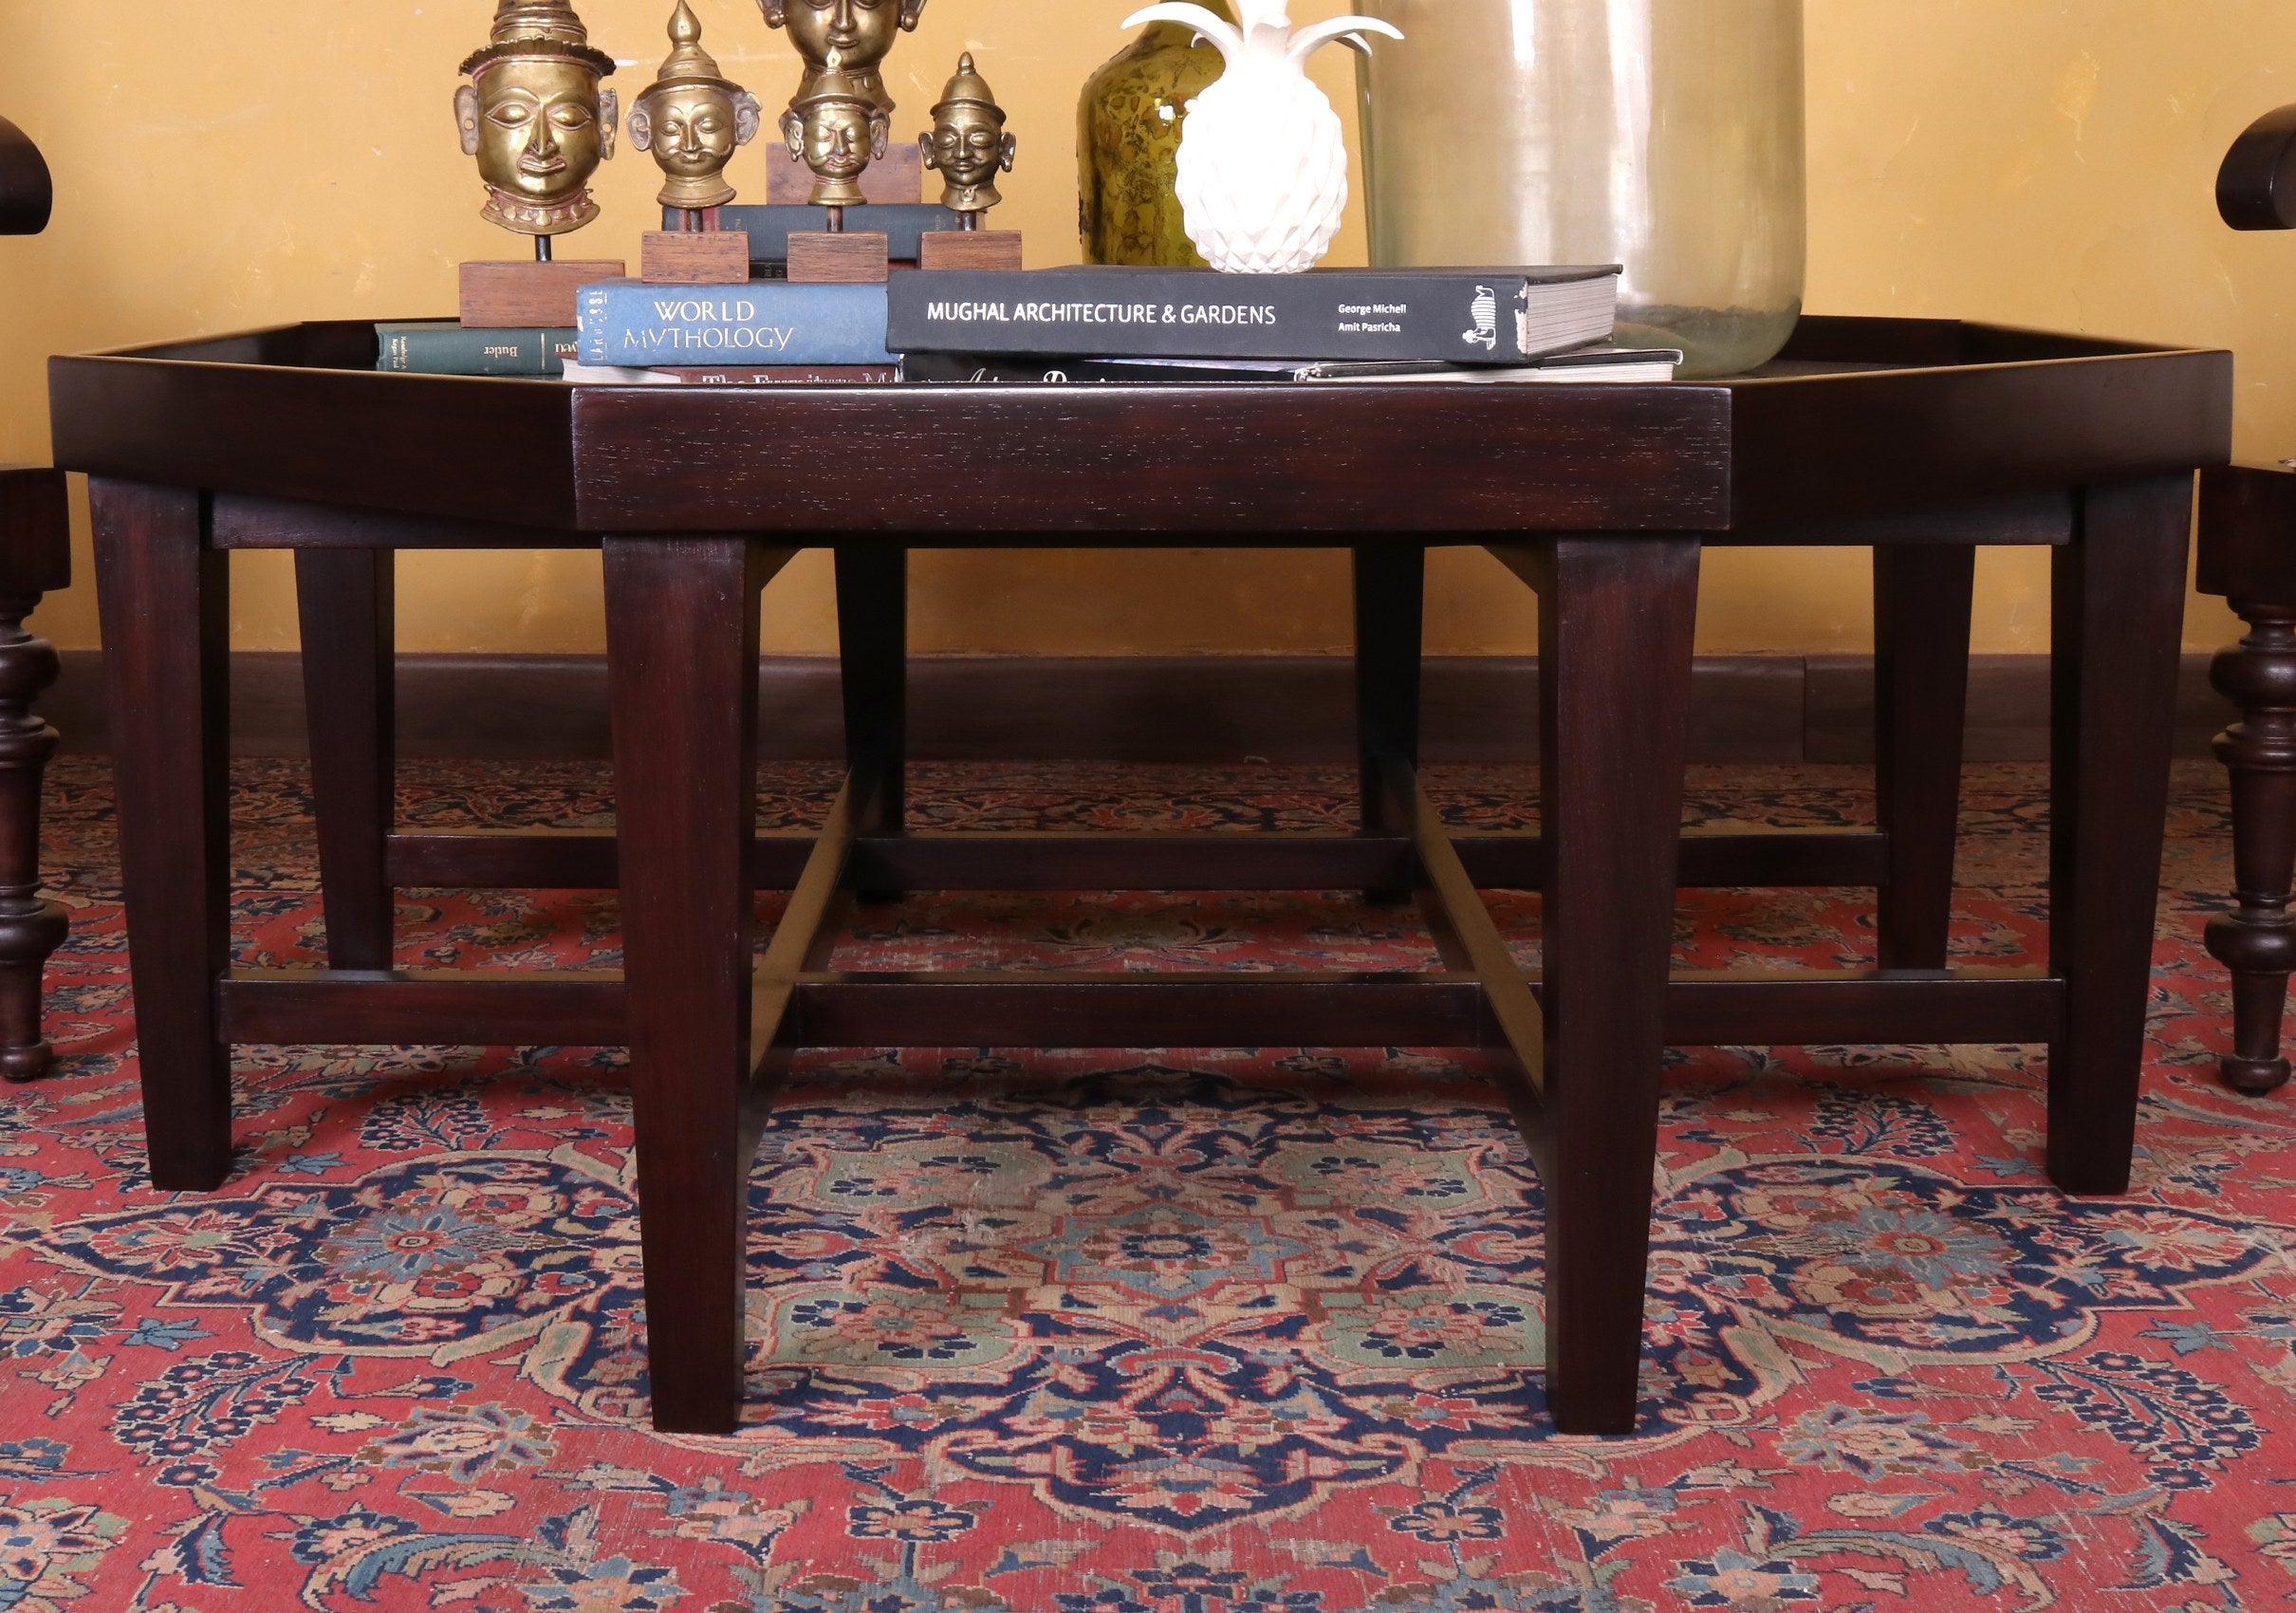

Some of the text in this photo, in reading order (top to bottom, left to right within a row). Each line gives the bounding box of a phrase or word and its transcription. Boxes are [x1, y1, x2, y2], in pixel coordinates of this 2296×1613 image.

[653, 301, 755, 323] WORLD
[927, 302, 1276, 324] MUGHAL ARCHITECTURE & GARDENS
[1338, 304, 1407, 315] George Michell
[1338, 322, 1401, 332] Amit Pasricha
[623, 326, 795, 352] MYTHOLOGY
[483, 345, 518, 359] Butler
